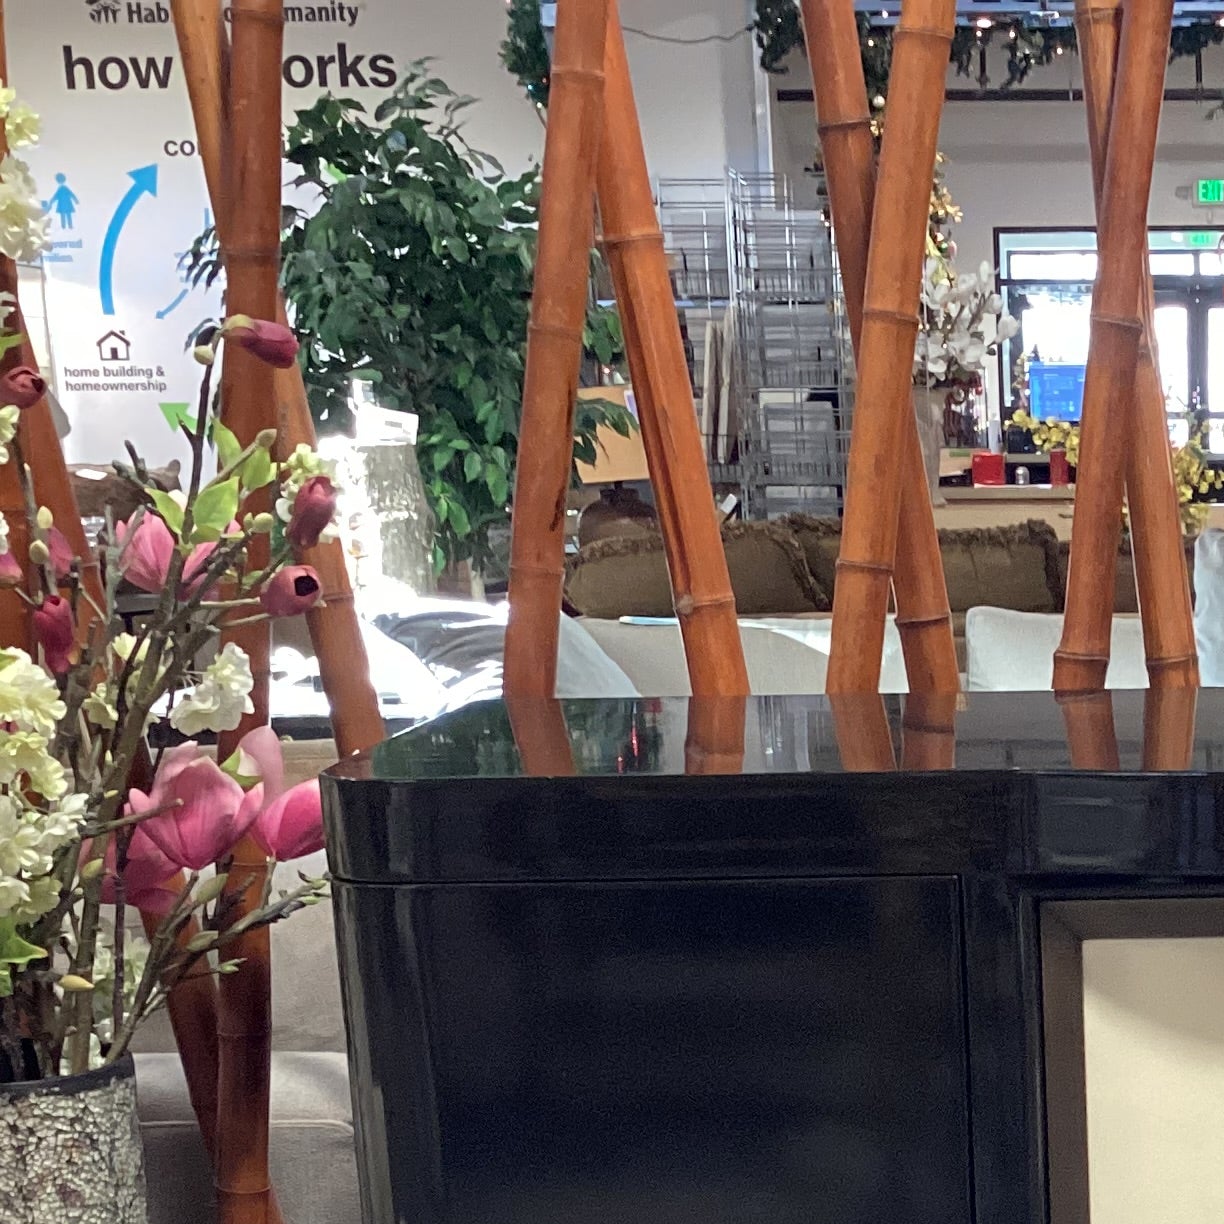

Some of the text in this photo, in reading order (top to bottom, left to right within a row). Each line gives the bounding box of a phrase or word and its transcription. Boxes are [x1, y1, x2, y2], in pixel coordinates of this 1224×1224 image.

[284, 0, 359, 26] manity
[62, 42, 398, 90] how orks
[1198, 180, 1224, 202] EXIT
[64, 366, 165, 379] home building &
[65, 381, 167, 392] homeownership
